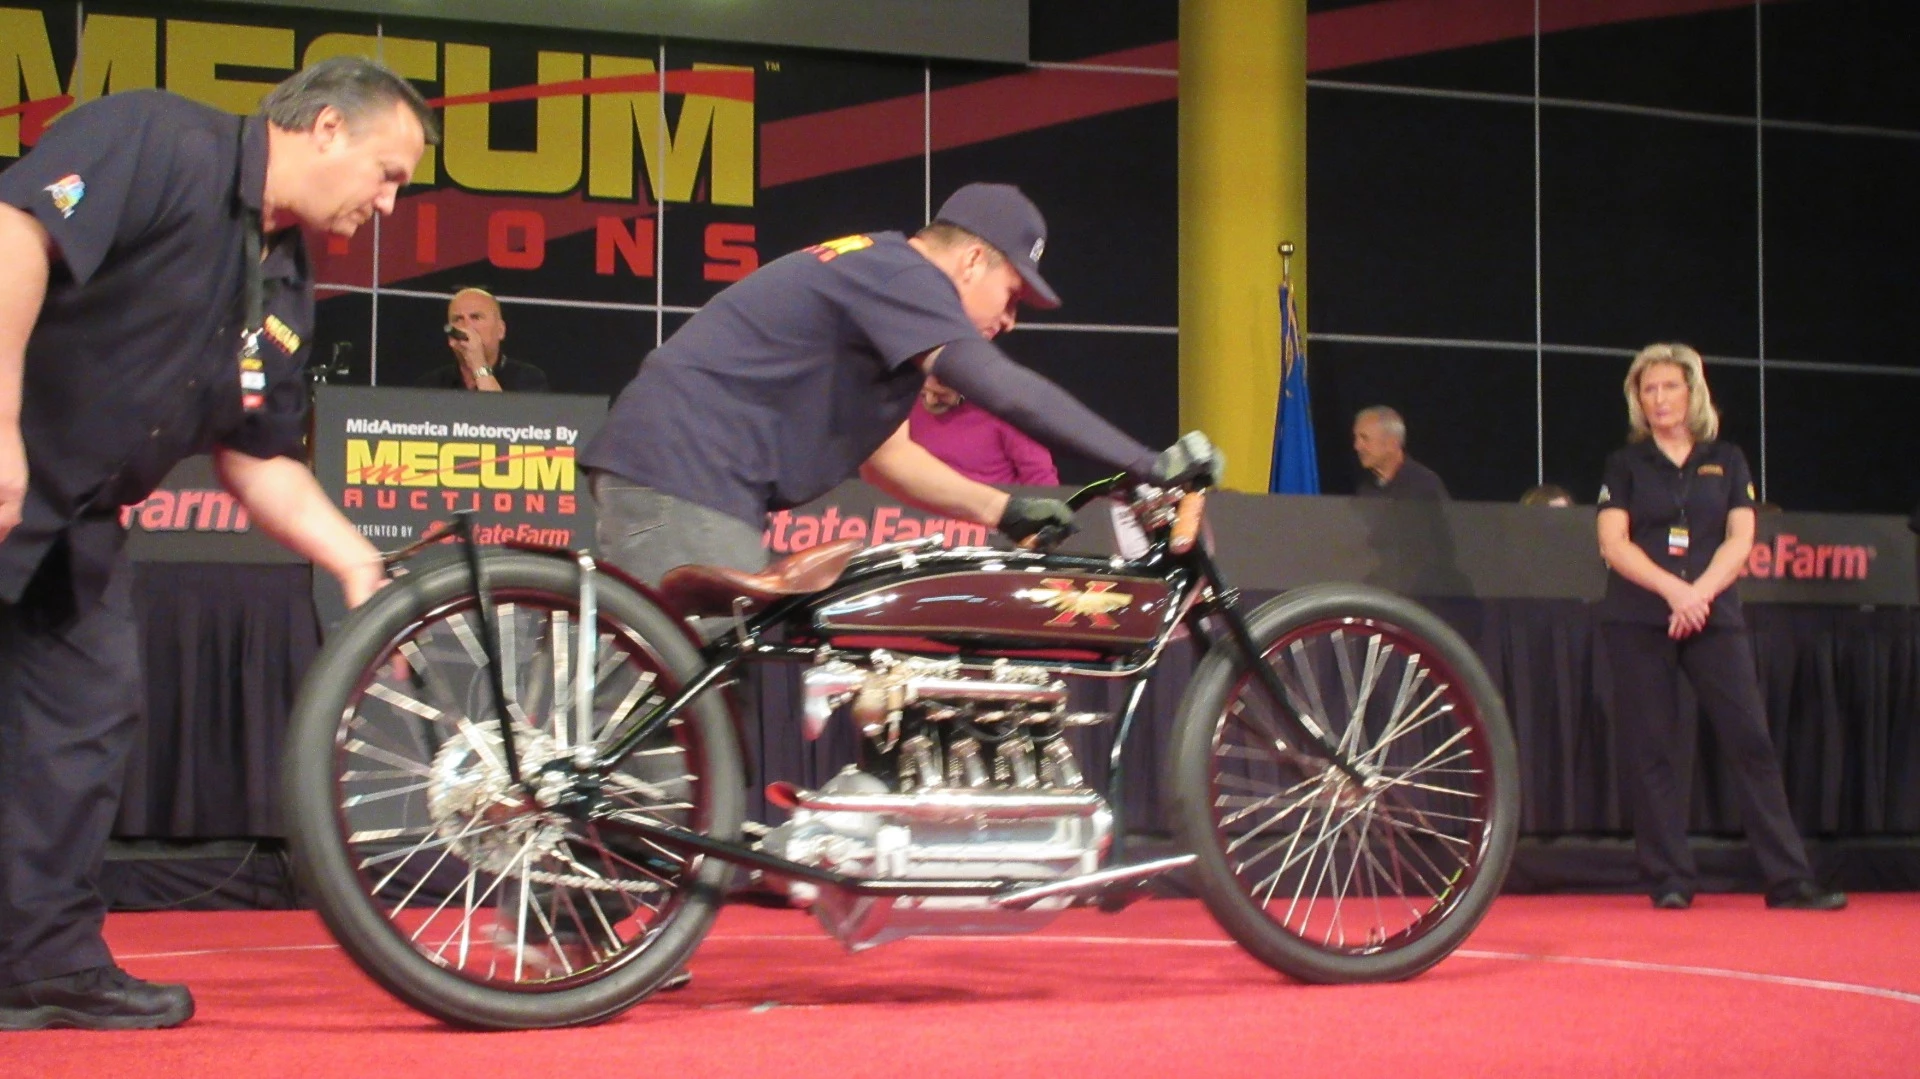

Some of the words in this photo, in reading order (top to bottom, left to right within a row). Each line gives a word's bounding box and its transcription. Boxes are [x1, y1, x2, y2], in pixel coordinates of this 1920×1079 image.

[346, 419, 448, 436] MidAmerica
[453, 423, 551, 443] Motorcycles
[556, 427, 578, 444] By
[346, 439, 576, 491] MECUM
[344, 488, 577, 514] AUCTIONS
[401, 525, 413, 538] BY
